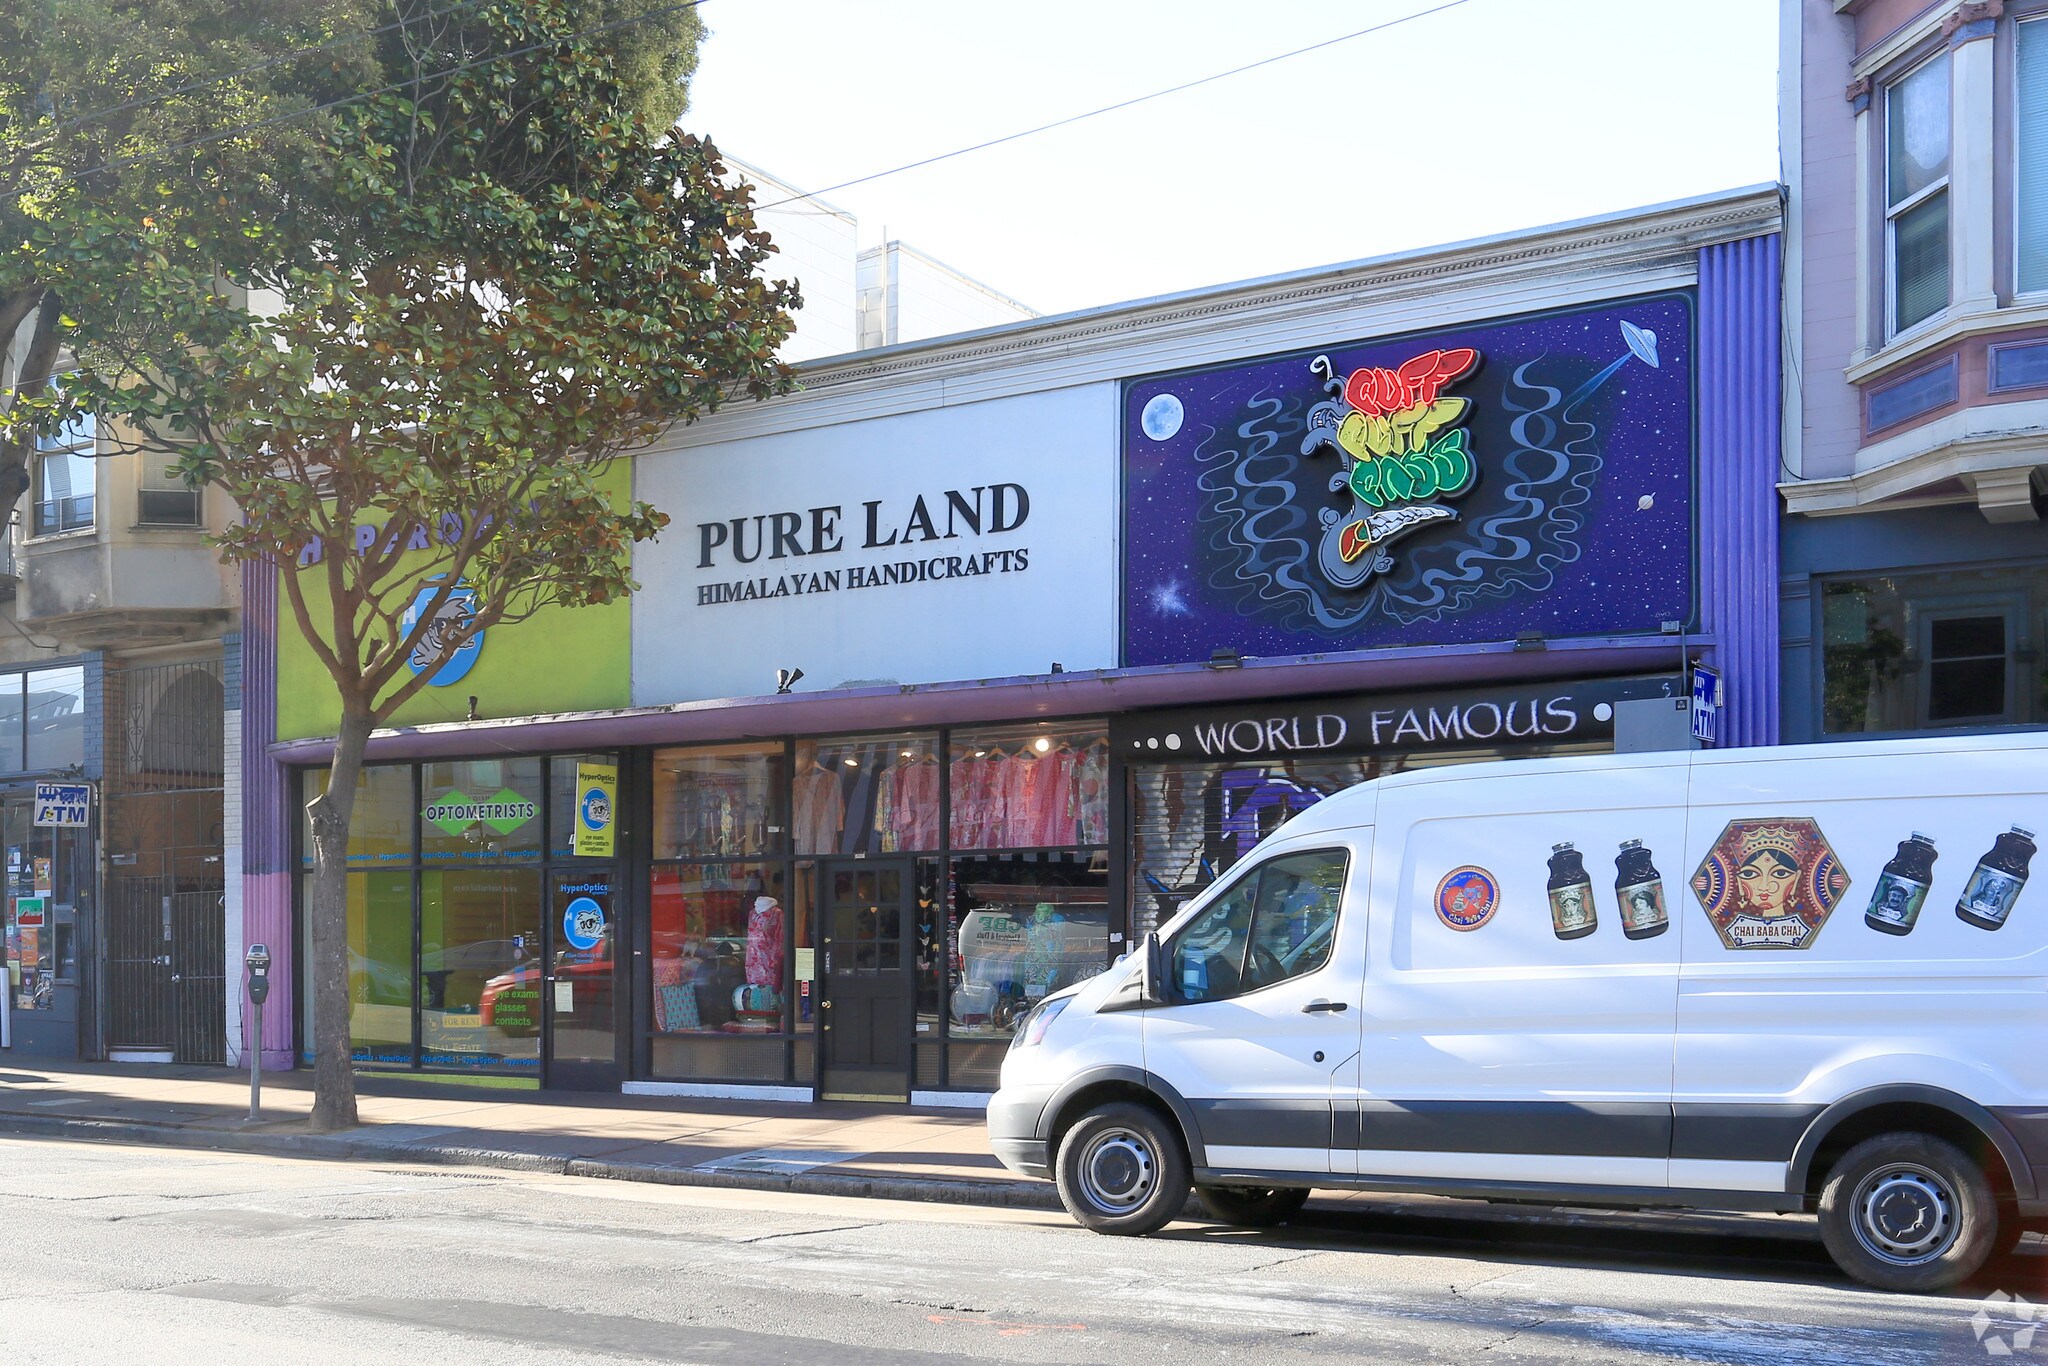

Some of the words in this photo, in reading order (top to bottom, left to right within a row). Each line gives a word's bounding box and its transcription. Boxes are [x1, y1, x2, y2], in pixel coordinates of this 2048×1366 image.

[697, 506, 844, 568] PURE
[861, 482, 1030, 549] LAND
[697, 570, 841, 606] HIMALAYAN
[846, 548, 1029, 589] HANDICRAFTS
[1194, 714, 1347, 755] WORLD
[1370, 697, 1578, 744] FAMOUS
[1693, 708, 1715, 738] ATM
[580, 772, 615, 782] HyperOptics
[38, 806, 85, 823] ATM
[426, 802, 534, 821] OPTOMETRISTS
[560, 883, 608, 894] HyperOptics
[1734, 926, 1754, 937] CHAI
[1756, 926, 1779, 937] BABA
[1781, 925, 1801, 937] CHAI
[495, 990, 510, 1000] eye
[511, 990, 539, 999] exams
[495, 1002, 527, 1013] glasses
[444, 1016, 458, 1027] FOR
[495, 1016, 531, 1026] contacts
